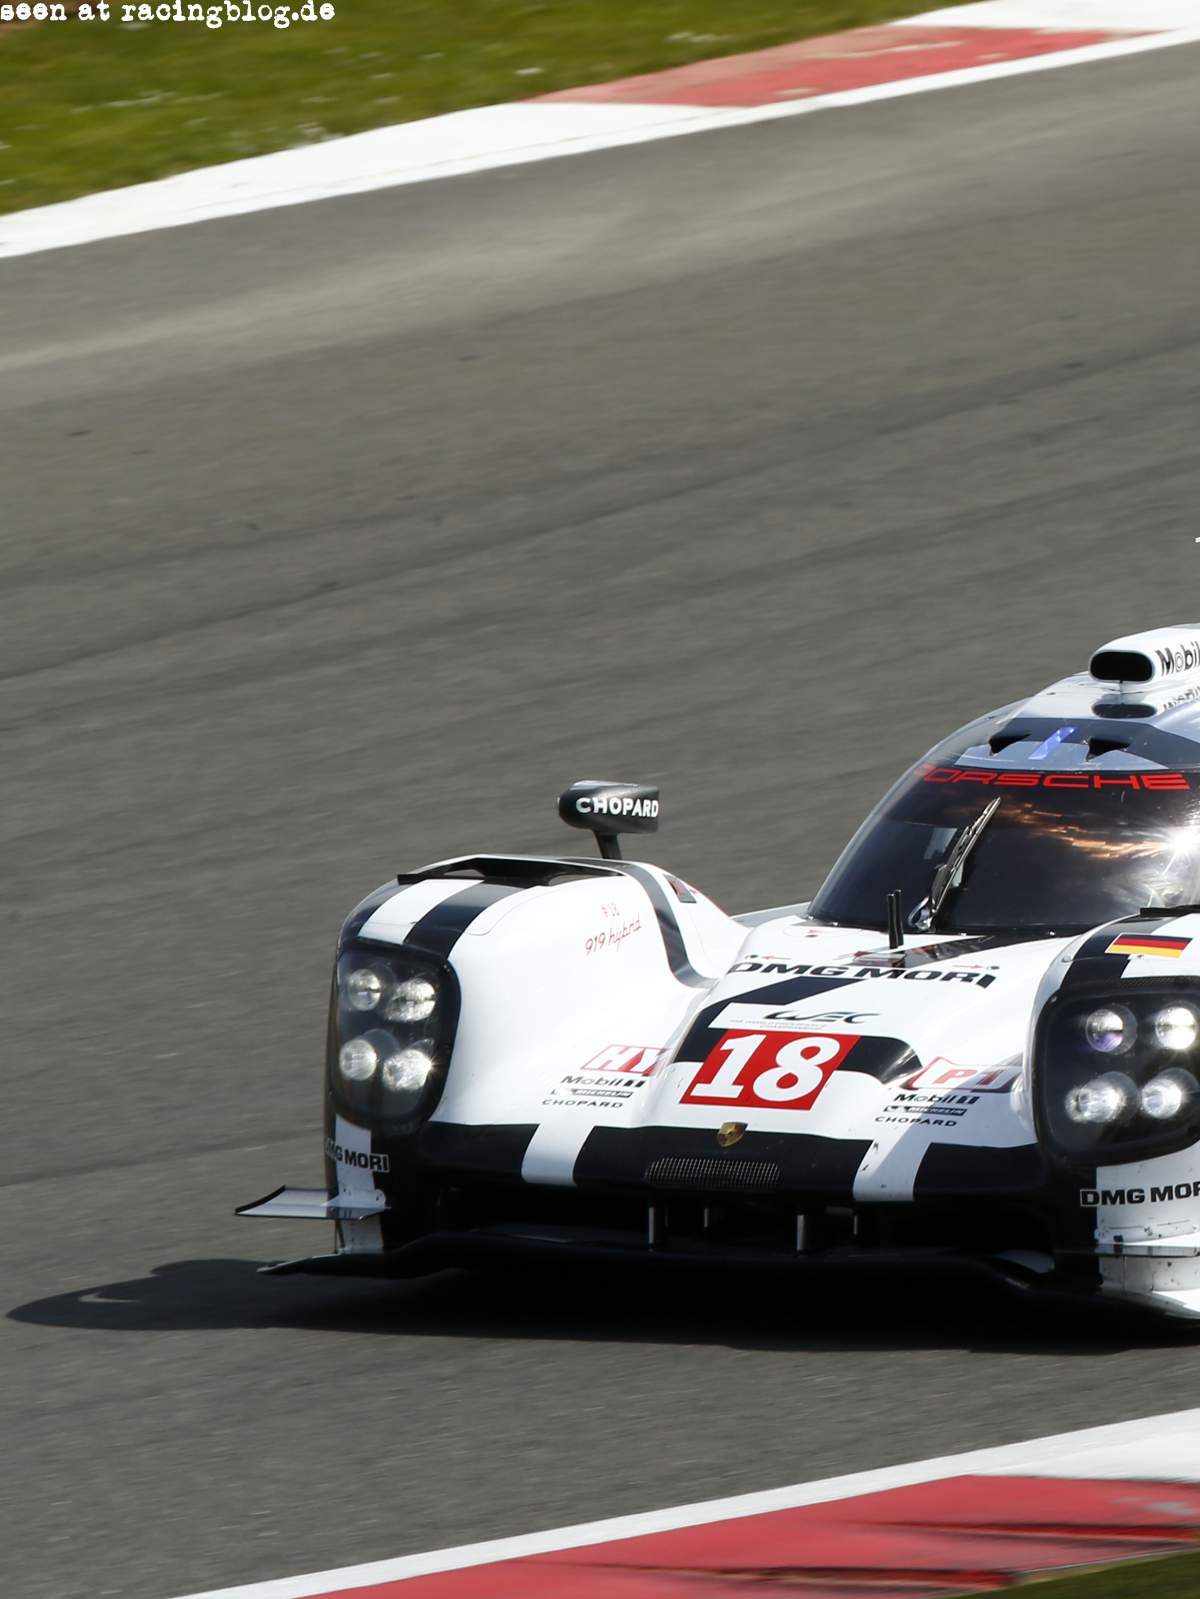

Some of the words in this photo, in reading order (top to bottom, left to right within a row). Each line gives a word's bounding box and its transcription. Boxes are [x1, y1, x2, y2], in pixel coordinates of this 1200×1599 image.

[576, 797, 659, 818] CHOPARD
[585, 932, 606, 955] 919
[726, 962, 848, 976] DMG
[855, 967, 997, 989] MORI
[763, 1010, 881, 1024] WEC
[582, 1045, 664, 1074] HY
[690, 1033, 841, 1102] 18
[542, 1099, 623, 1109] CHOPARD
[875, 1116, 958, 1127] CHOPARD
[344, 1149, 389, 1173] MORI
[1080, 1188, 1146, 1206] DMG
